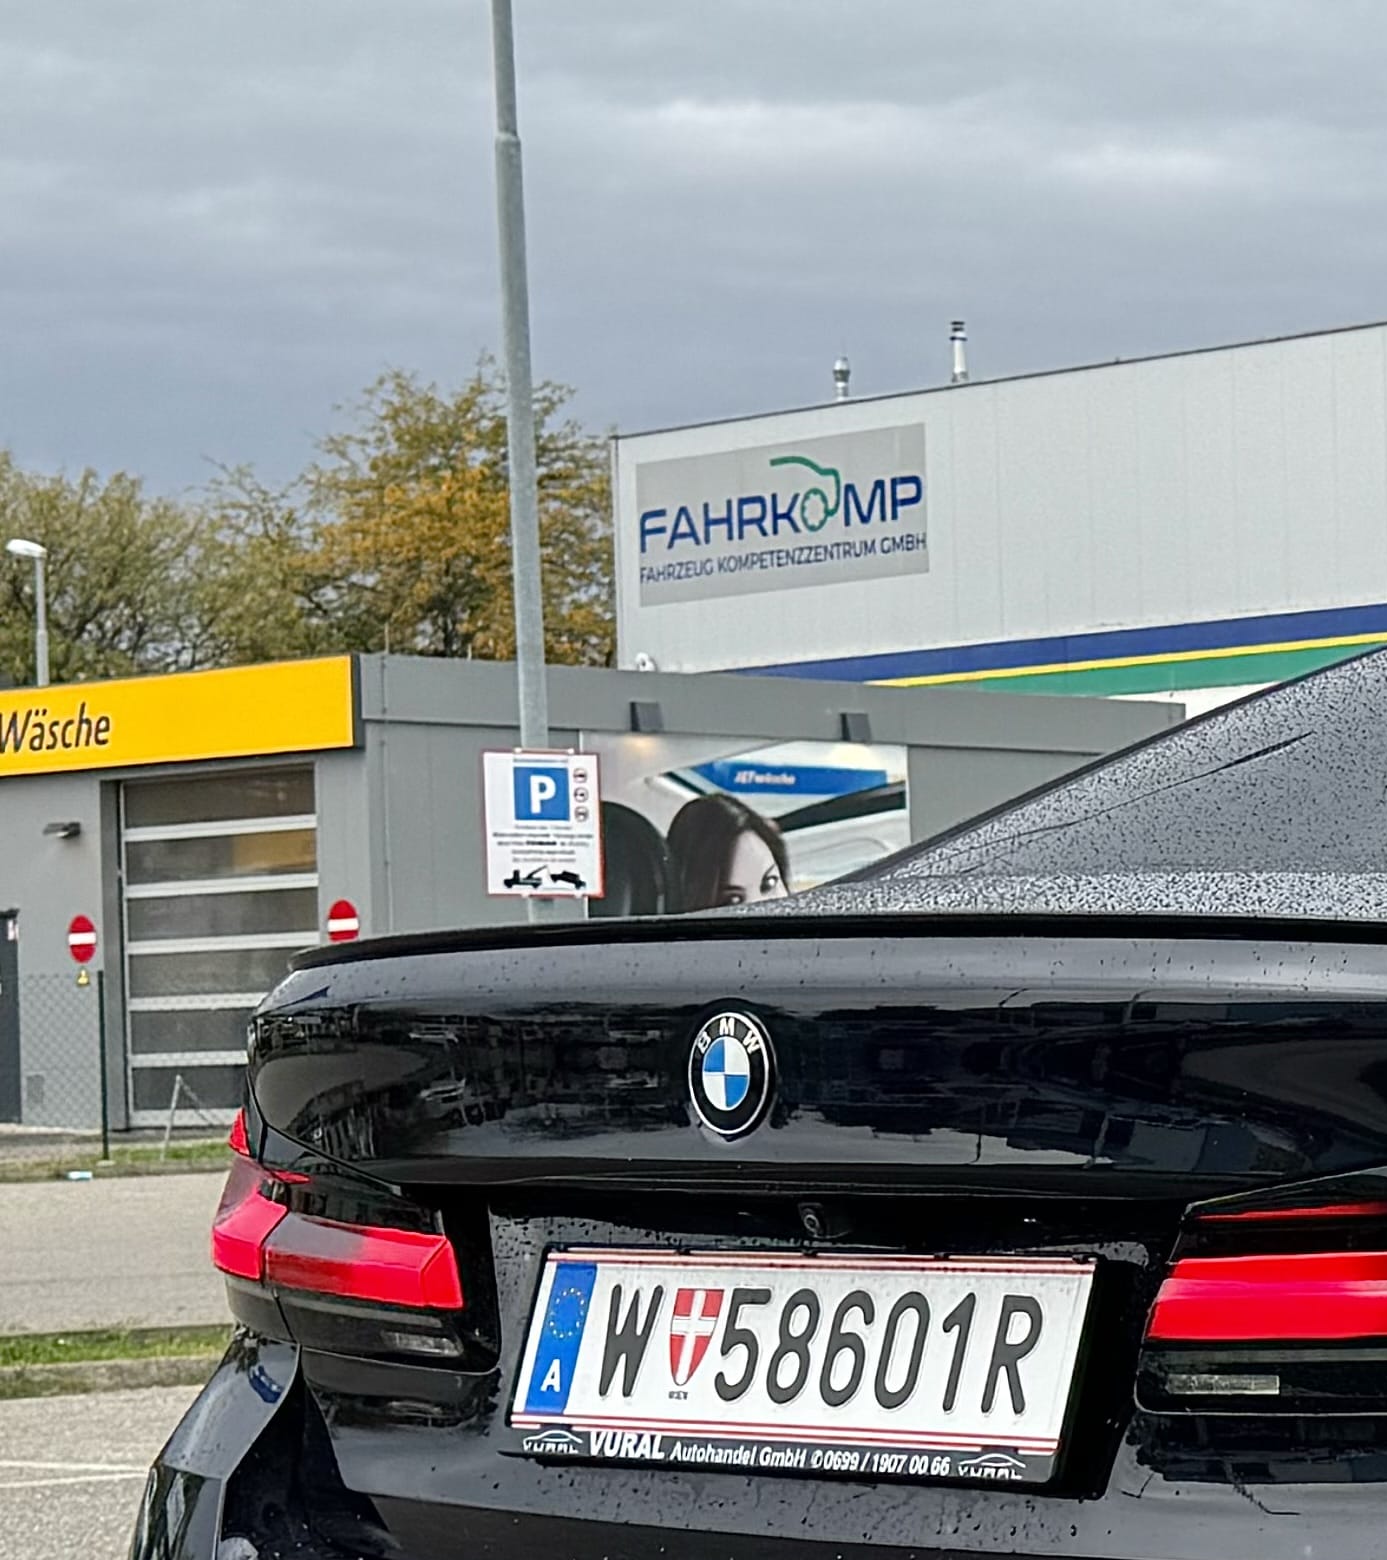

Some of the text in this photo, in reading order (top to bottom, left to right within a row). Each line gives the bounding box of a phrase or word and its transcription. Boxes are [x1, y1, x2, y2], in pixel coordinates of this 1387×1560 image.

[640, 475, 922, 553] FAHRKOMP
[640, 532, 927, 584] FAHRZEUG KOMPETENZZENTRUM GMBH
[0, 701, 111, 753] Wäsche
[530, 774, 557, 815] P
[696, 1017, 762, 1055] BMW
[598, 1284, 1043, 1415] W 58601R
[540, 1358, 561, 1393] A
[590, 1431, 665, 1460] VURAL
[669, 1441, 758, 1465] Autohandel
[760, 1446, 807, 1468] GmbH
[872, 1453, 908, 1473] 1907
[930, 1456, 951, 1476] 66
